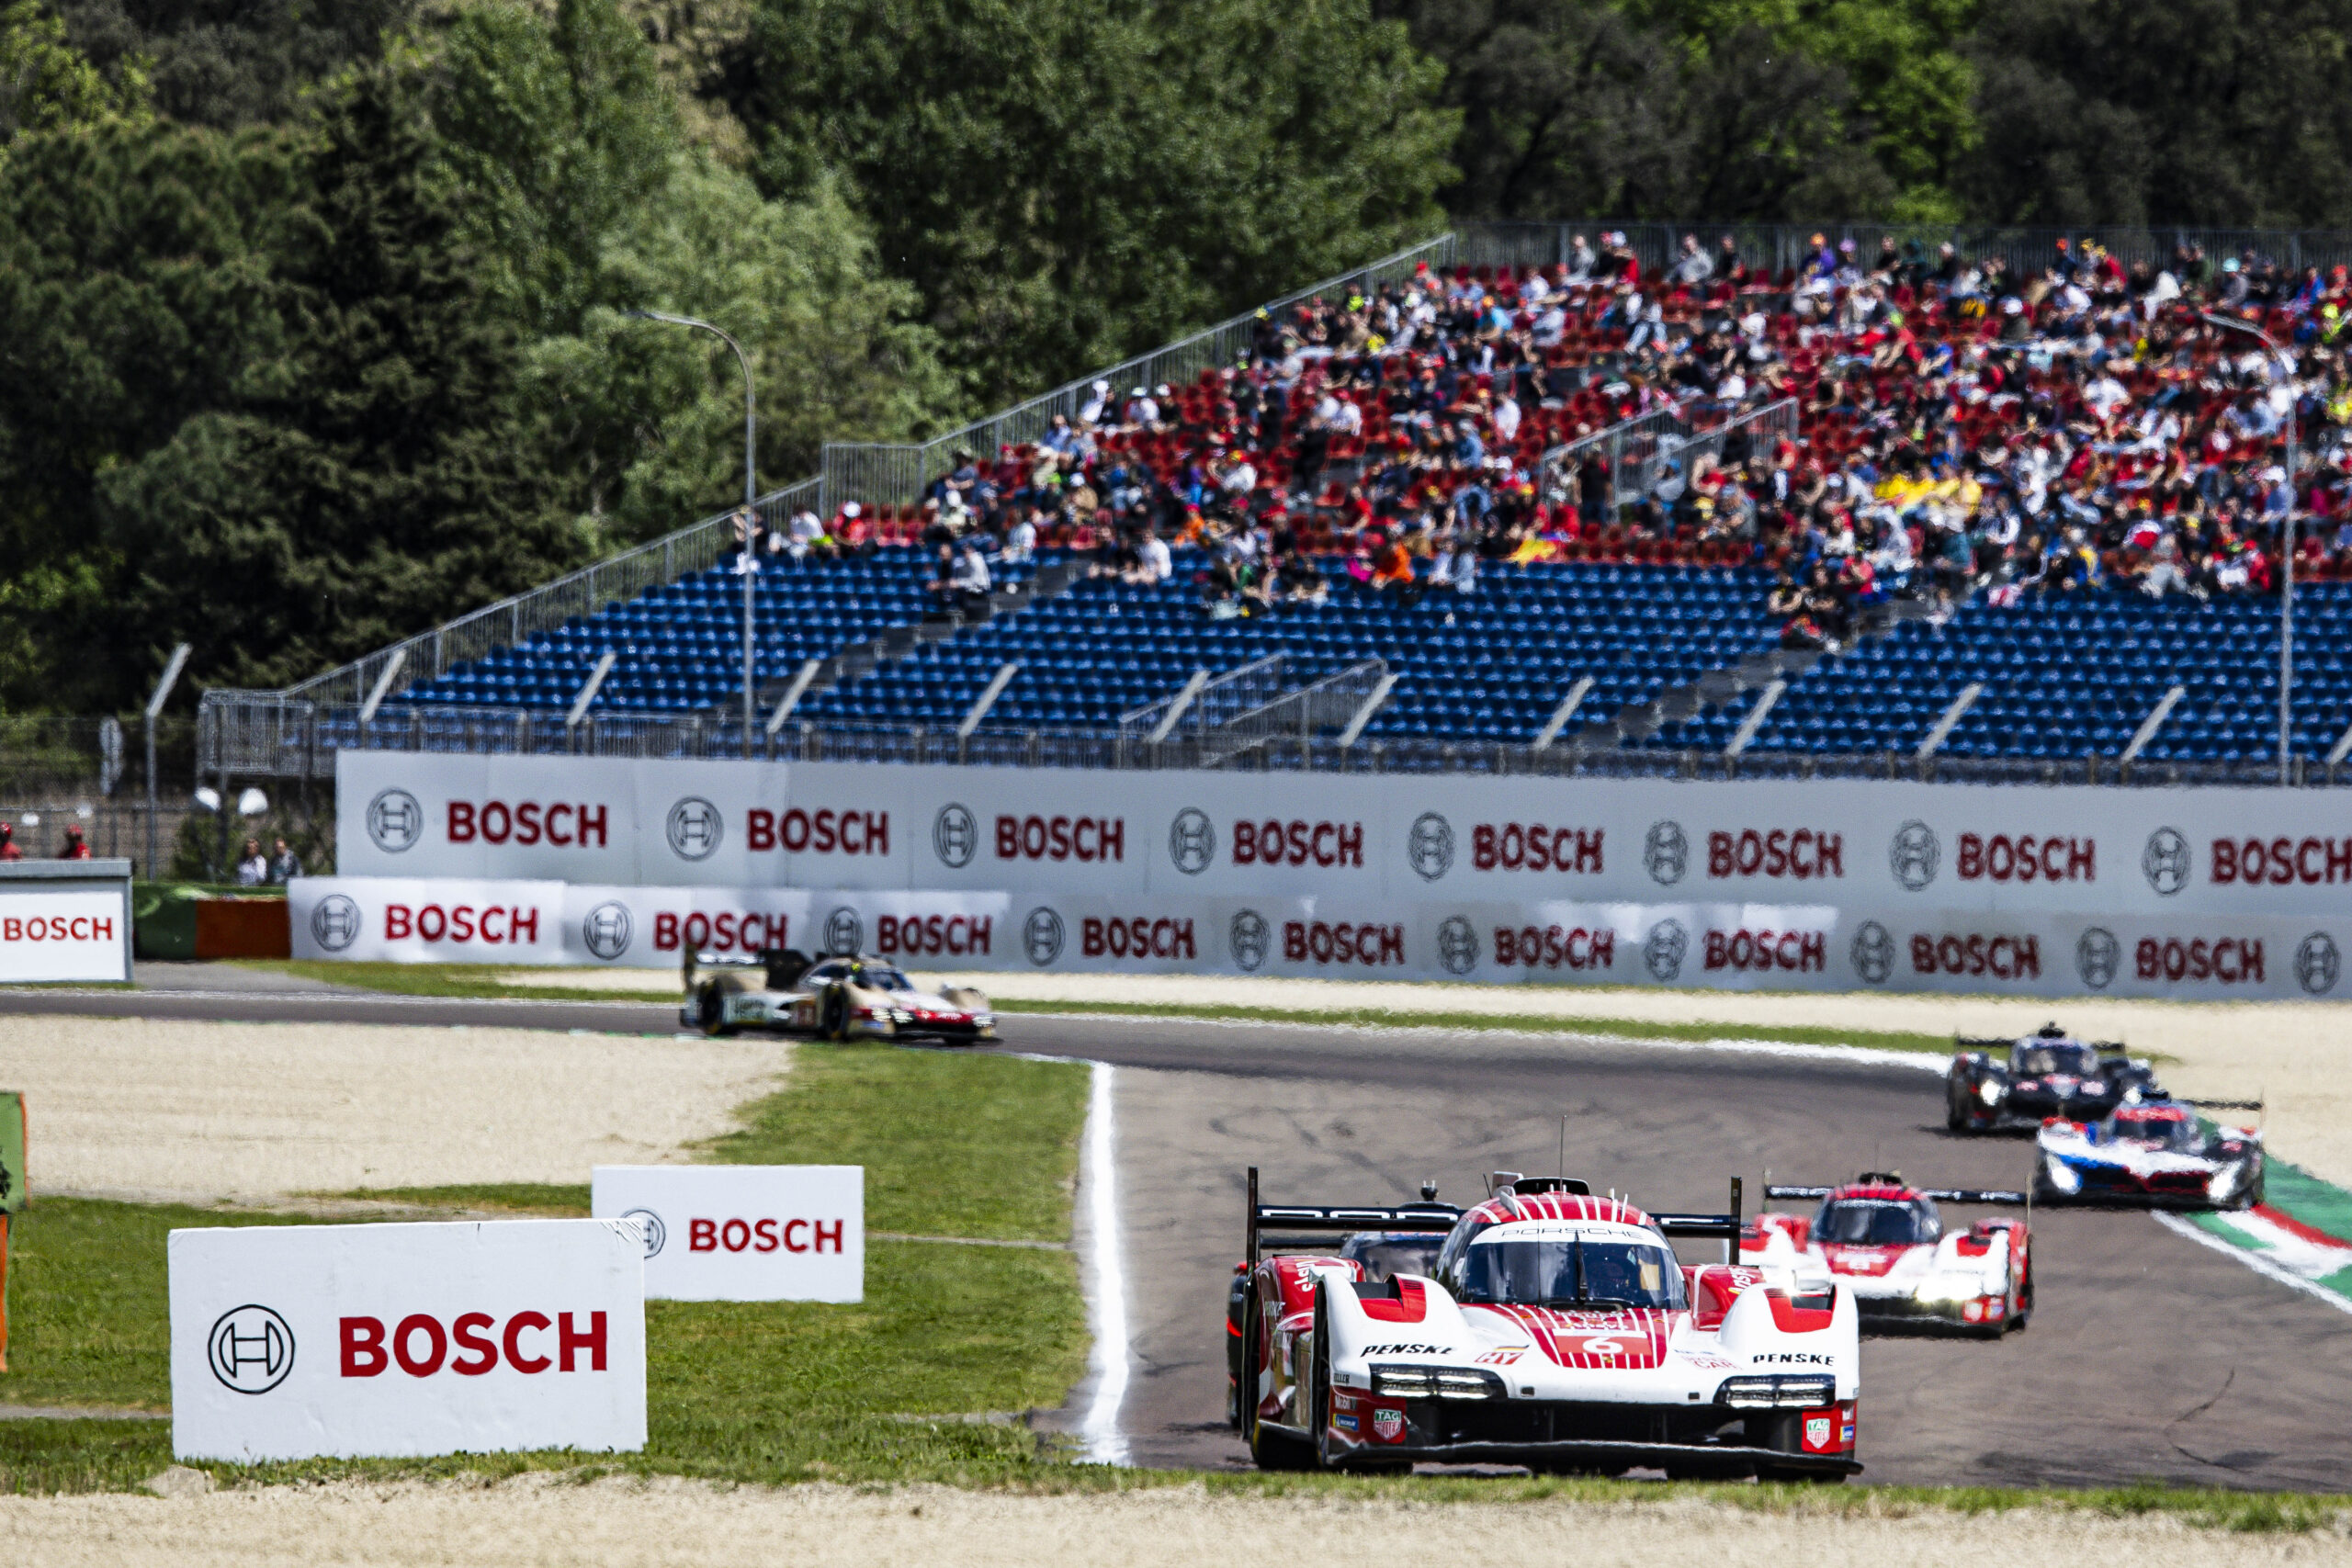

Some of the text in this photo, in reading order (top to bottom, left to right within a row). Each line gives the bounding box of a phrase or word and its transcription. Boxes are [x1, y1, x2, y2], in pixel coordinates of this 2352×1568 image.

[449, 802, 605, 845] BOSCH
[749, 810, 887, 853] BOSCH
[998, 818, 1122, 859] BOSCH
[1235, 822, 1361, 865] BOSCH
[1476, 825, 1600, 870] BOSCH
[1711, 830, 1840, 876] BOSCH
[1960, 835, 2093, 880] BOSCH
[2213, 839, 2352, 884] BOSCH
[3, 916, 113, 942] BOSCH
[385, 904, 537, 944] BOSCH
[654, 912, 786, 951] BOSCH
[879, 916, 989, 954] BOSCH
[1083, 919, 1193, 958] BOSCH
[1285, 923, 1403, 965] BOSCH
[1495, 928, 1612, 967] BOSCH
[1706, 930, 1823, 970] BOSCH
[1913, 935, 2039, 976] BOSCH
[2136, 940, 2264, 982] BOSCH
[689, 1218, 843, 1254] BOSCH
[1502, 1227, 1645, 1239] PORSCHE
[339, 1311, 607, 1378] BOSCH
[1360, 1344, 1455, 1358] PENSKE
[1476, 1351, 1521, 1365] HY
[1582, 1337, 1623, 1354] 6
[1752, 1353, 1836, 1367] PENSKE
[1376, 1410, 1399, 1421] TAG
